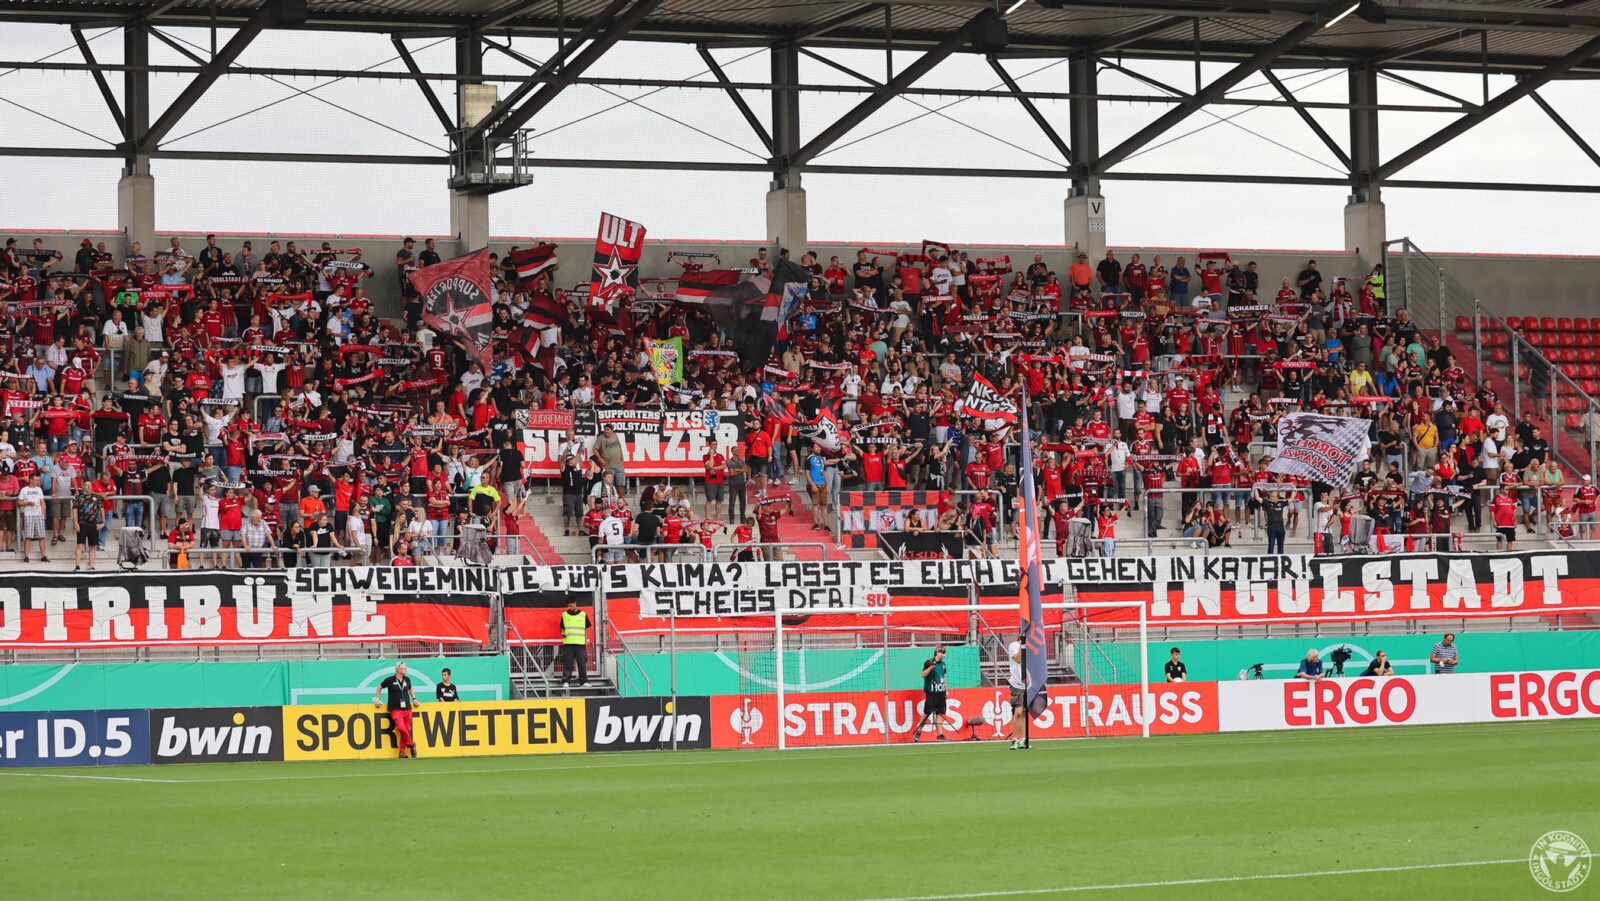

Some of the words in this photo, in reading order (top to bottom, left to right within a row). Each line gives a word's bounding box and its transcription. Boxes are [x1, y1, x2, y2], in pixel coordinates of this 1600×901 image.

[1091, 202, 1101, 214] V
[602, 214, 641, 249] ULT
[1229, 305, 1269, 313] SCHANZER
[434, 355, 442, 368] 9
[529, 413, 572, 425] SUPREMUS
[598, 410, 660, 419] SUPPORTERS
[664, 411, 703, 428] FKS
[600, 422, 660, 431] IGOLSTADT
[612, 523, 620, 535] 5
[296, 566, 541, 593] SCHWEIGEMINUTE
[641, 563, 743, 588] KLIMA?
[765, 562, 863, 587] LASST
[870, 561, 905, 585] ES
[921, 560, 995, 585] EUCH
[1002, 558, 1057, 584] GT
[1068, 557, 1158, 582] GEHEN
[1170, 556, 1195, 581] IN
[1203, 555, 1307, 581] KATAR!
[1151, 555, 1569, 617] INGOLSTADT
[656, 589, 775, 615] SCHEISS
[866, 593, 887, 608] SU
[1284, 678, 1416, 726] ERGO
[594, 701, 701, 744] bwin
[37, 717, 132, 758] ID.5
[157, 712, 273, 756] bwin
